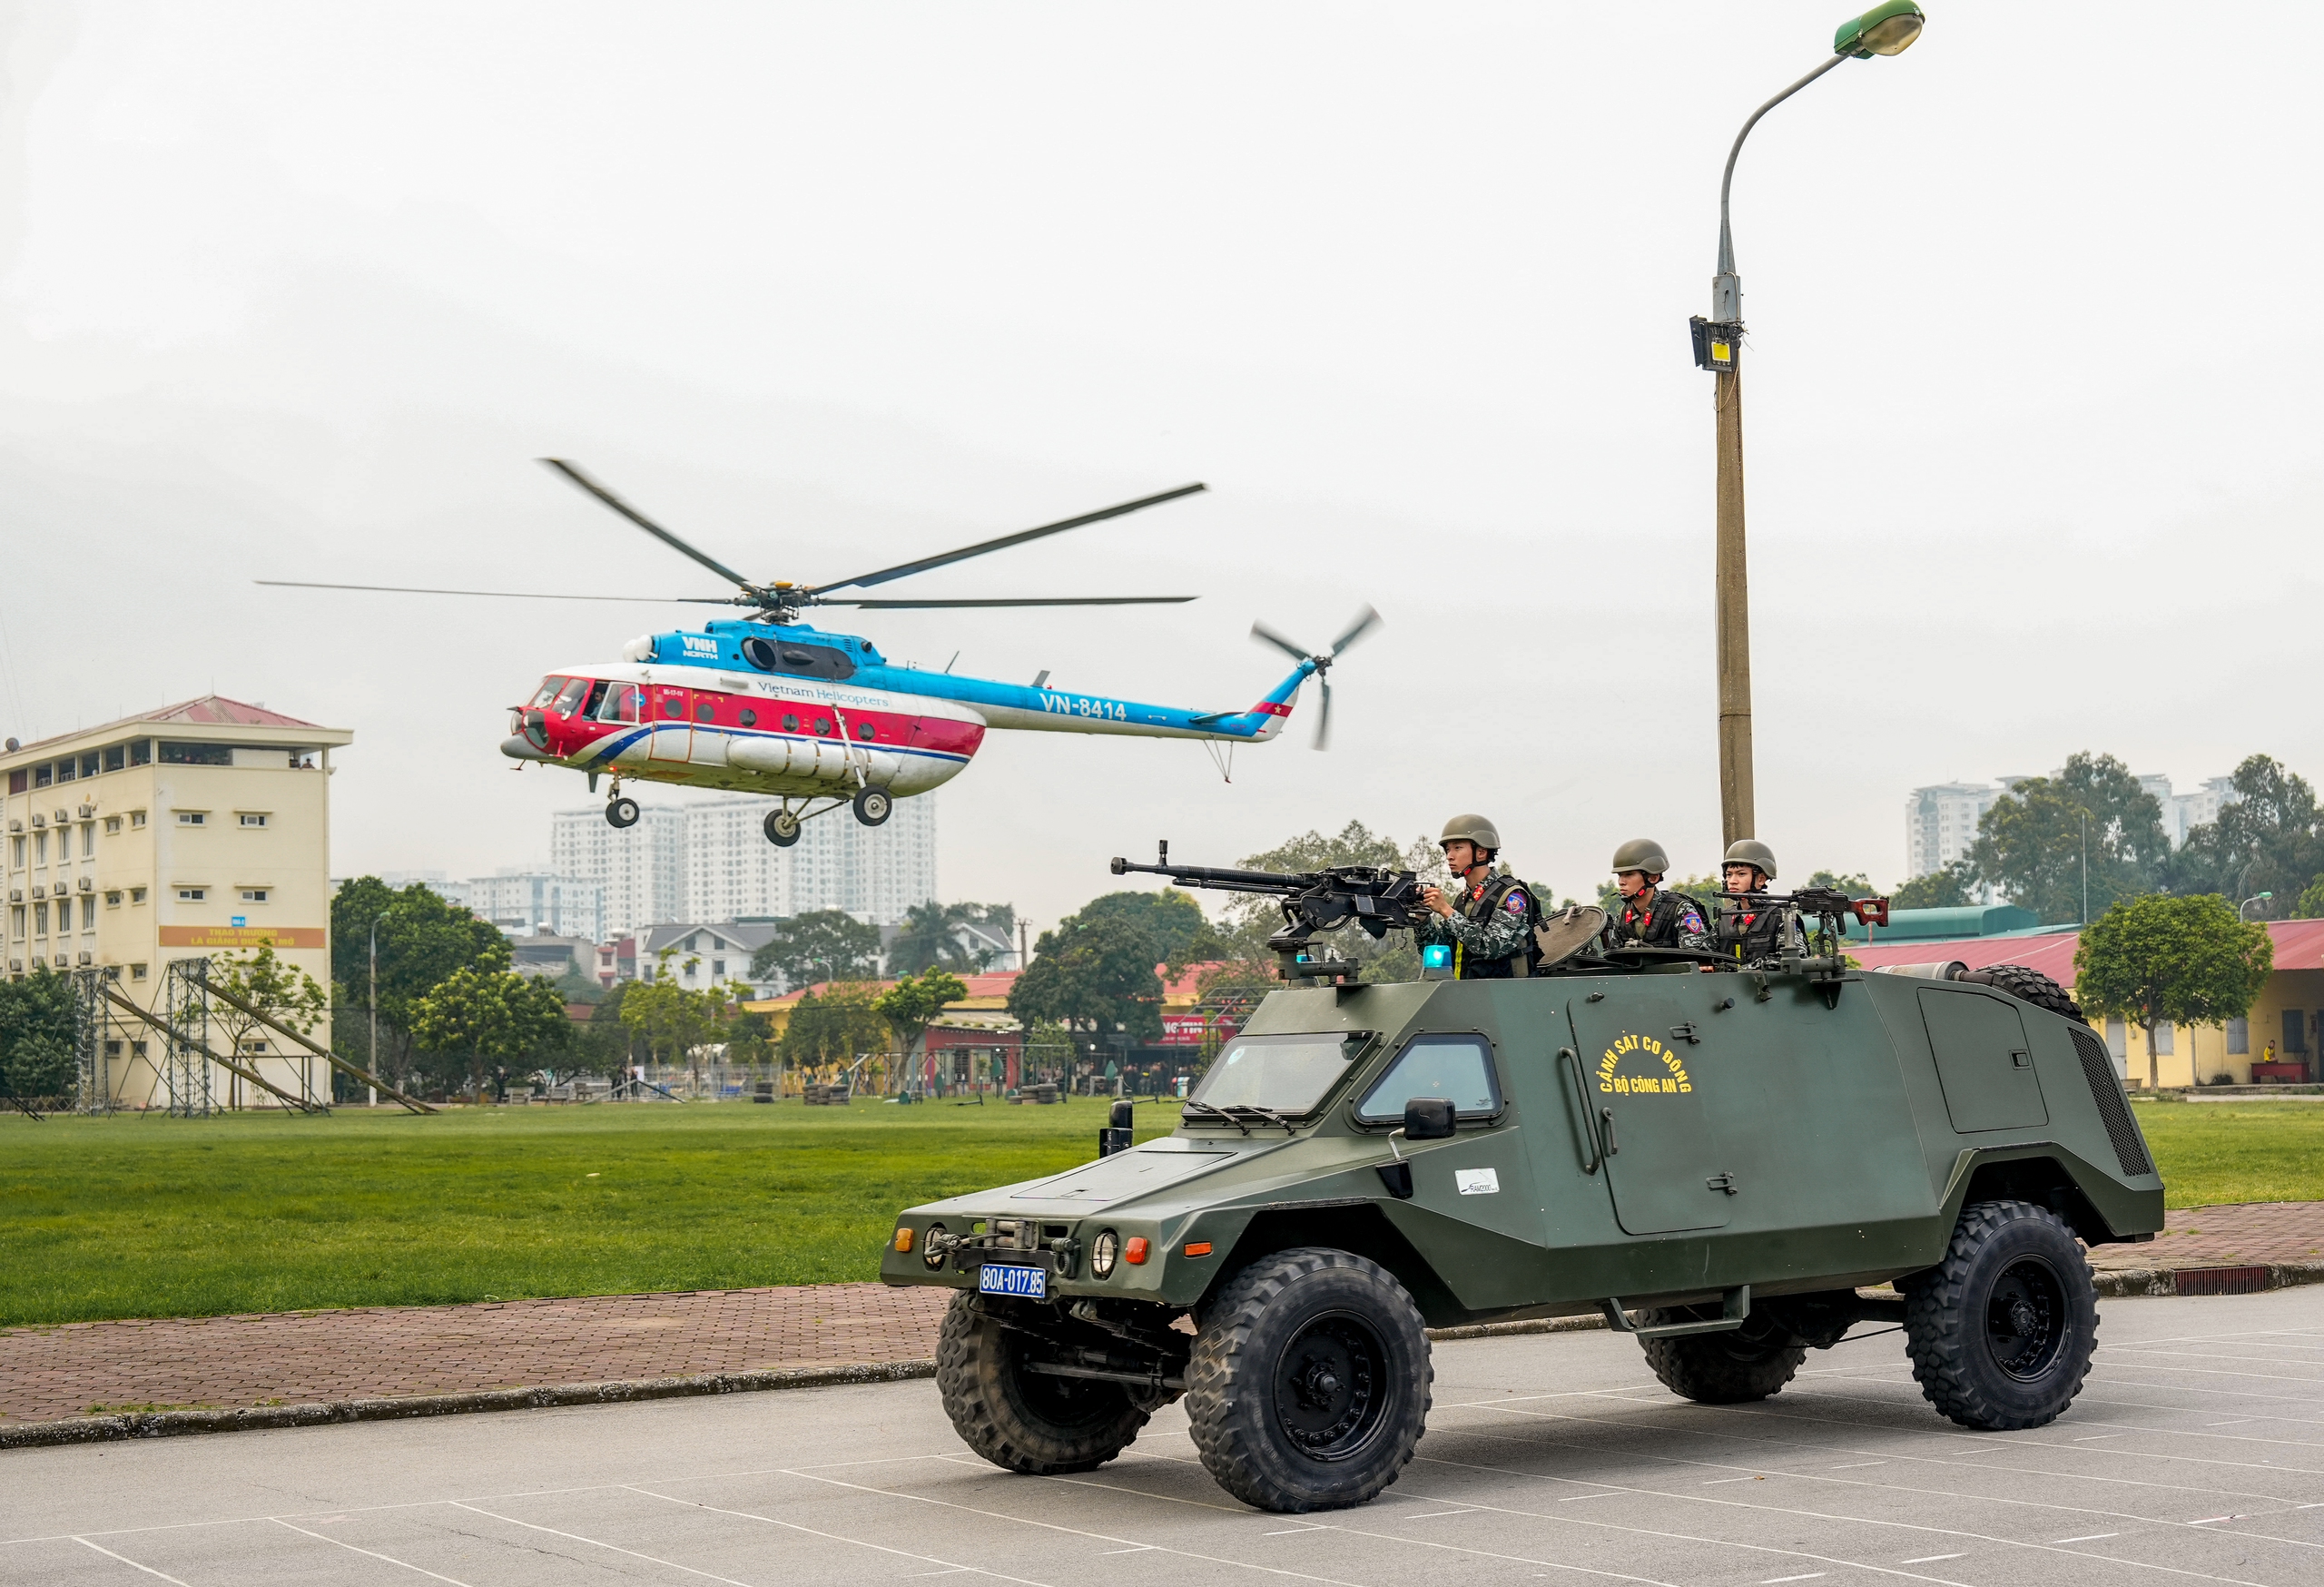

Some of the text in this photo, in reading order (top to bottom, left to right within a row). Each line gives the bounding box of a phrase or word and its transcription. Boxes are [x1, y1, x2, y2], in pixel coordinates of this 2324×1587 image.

[682, 636, 718, 653] VNH
[683, 650, 719, 660] NORTH
[757, 682, 889, 707] Vietnam Helicopters
[1039, 693, 1127, 721] VN-8414
[1596, 1049, 1620, 1093] CẢNH
[1642, 1036, 1661, 1055] CƠ
[1662, 1050, 1692, 1093] ĐỘNG
[1613, 1075, 1678, 1096] BỘ CÔNG AN
[982, 1267, 1043, 1294] 80A-017.85
